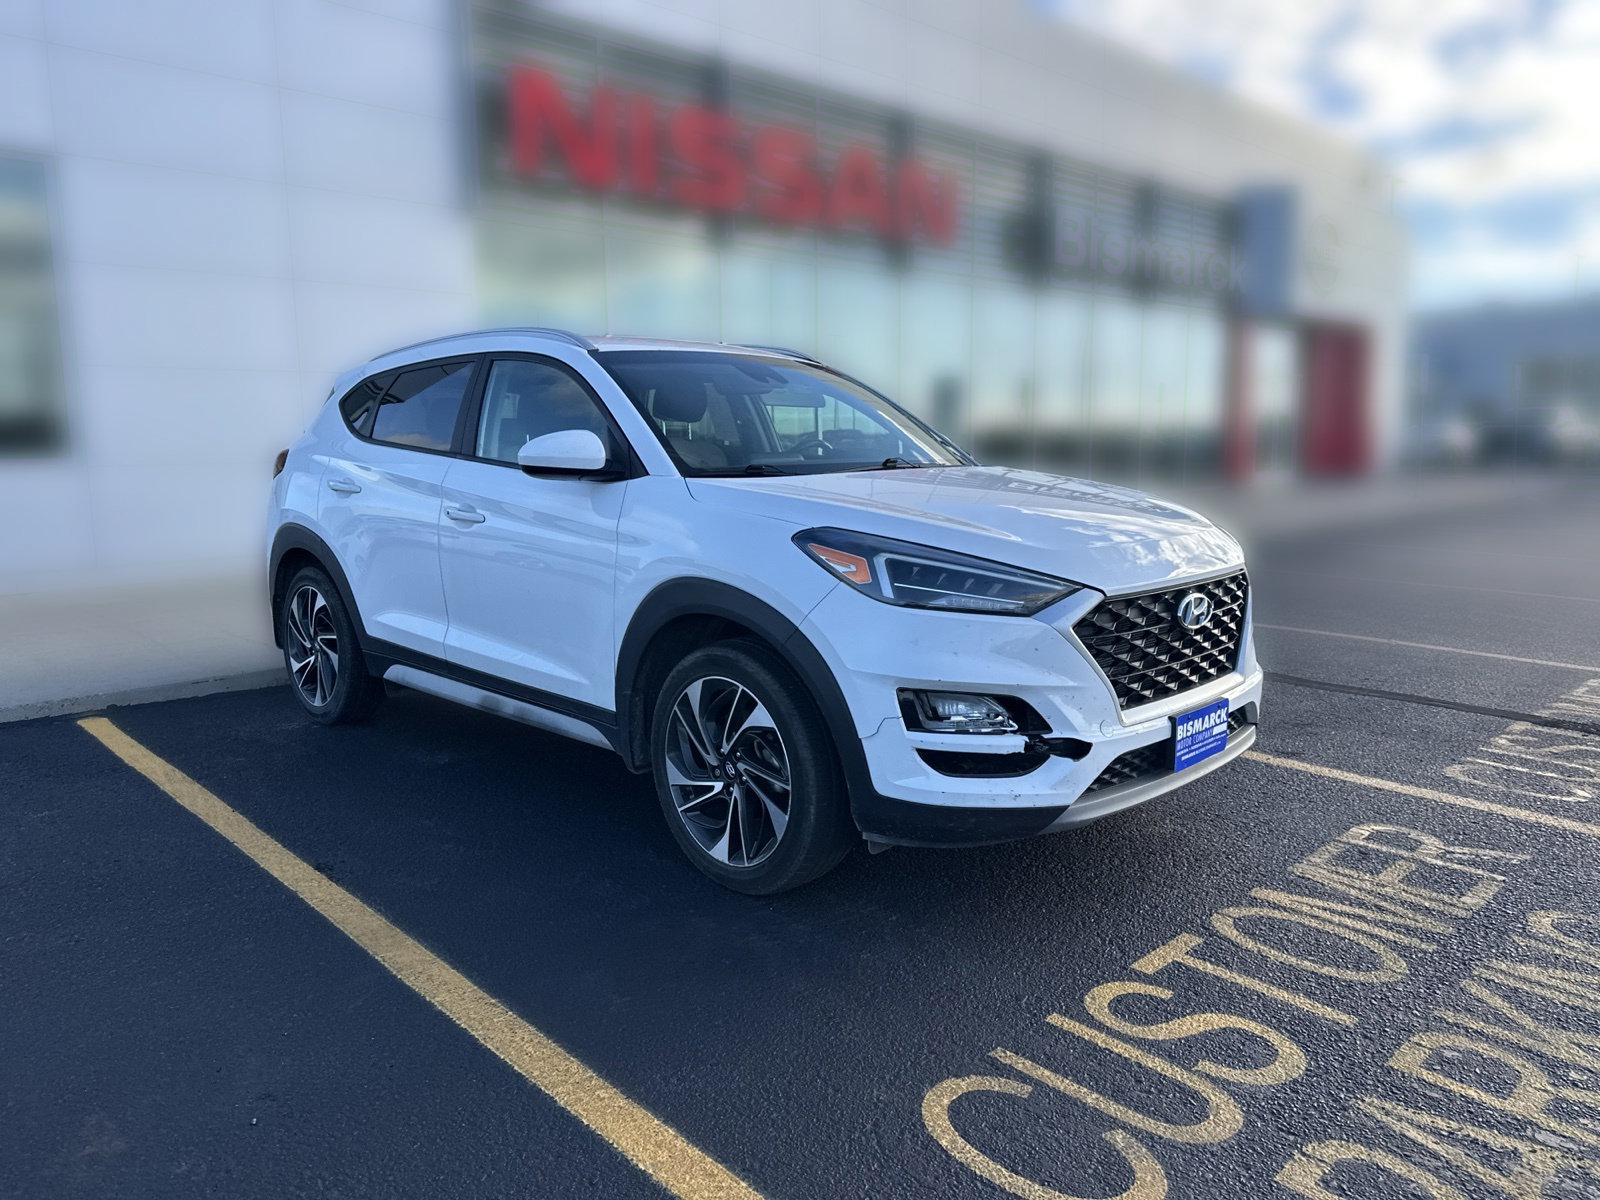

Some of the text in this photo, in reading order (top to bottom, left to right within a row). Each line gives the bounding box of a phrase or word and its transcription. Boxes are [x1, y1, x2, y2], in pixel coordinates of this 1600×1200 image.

[505, 63, 958, 246] NISSAN
[1055, 206, 1247, 294] Bismarck
[1176, 737, 1192, 751] MOTOR
[1193, 729, 1213, 744] COMPANY
[1177, 707, 1228, 740] BISMARCK
[921, 822, 1531, 1200] CUSTOMER
